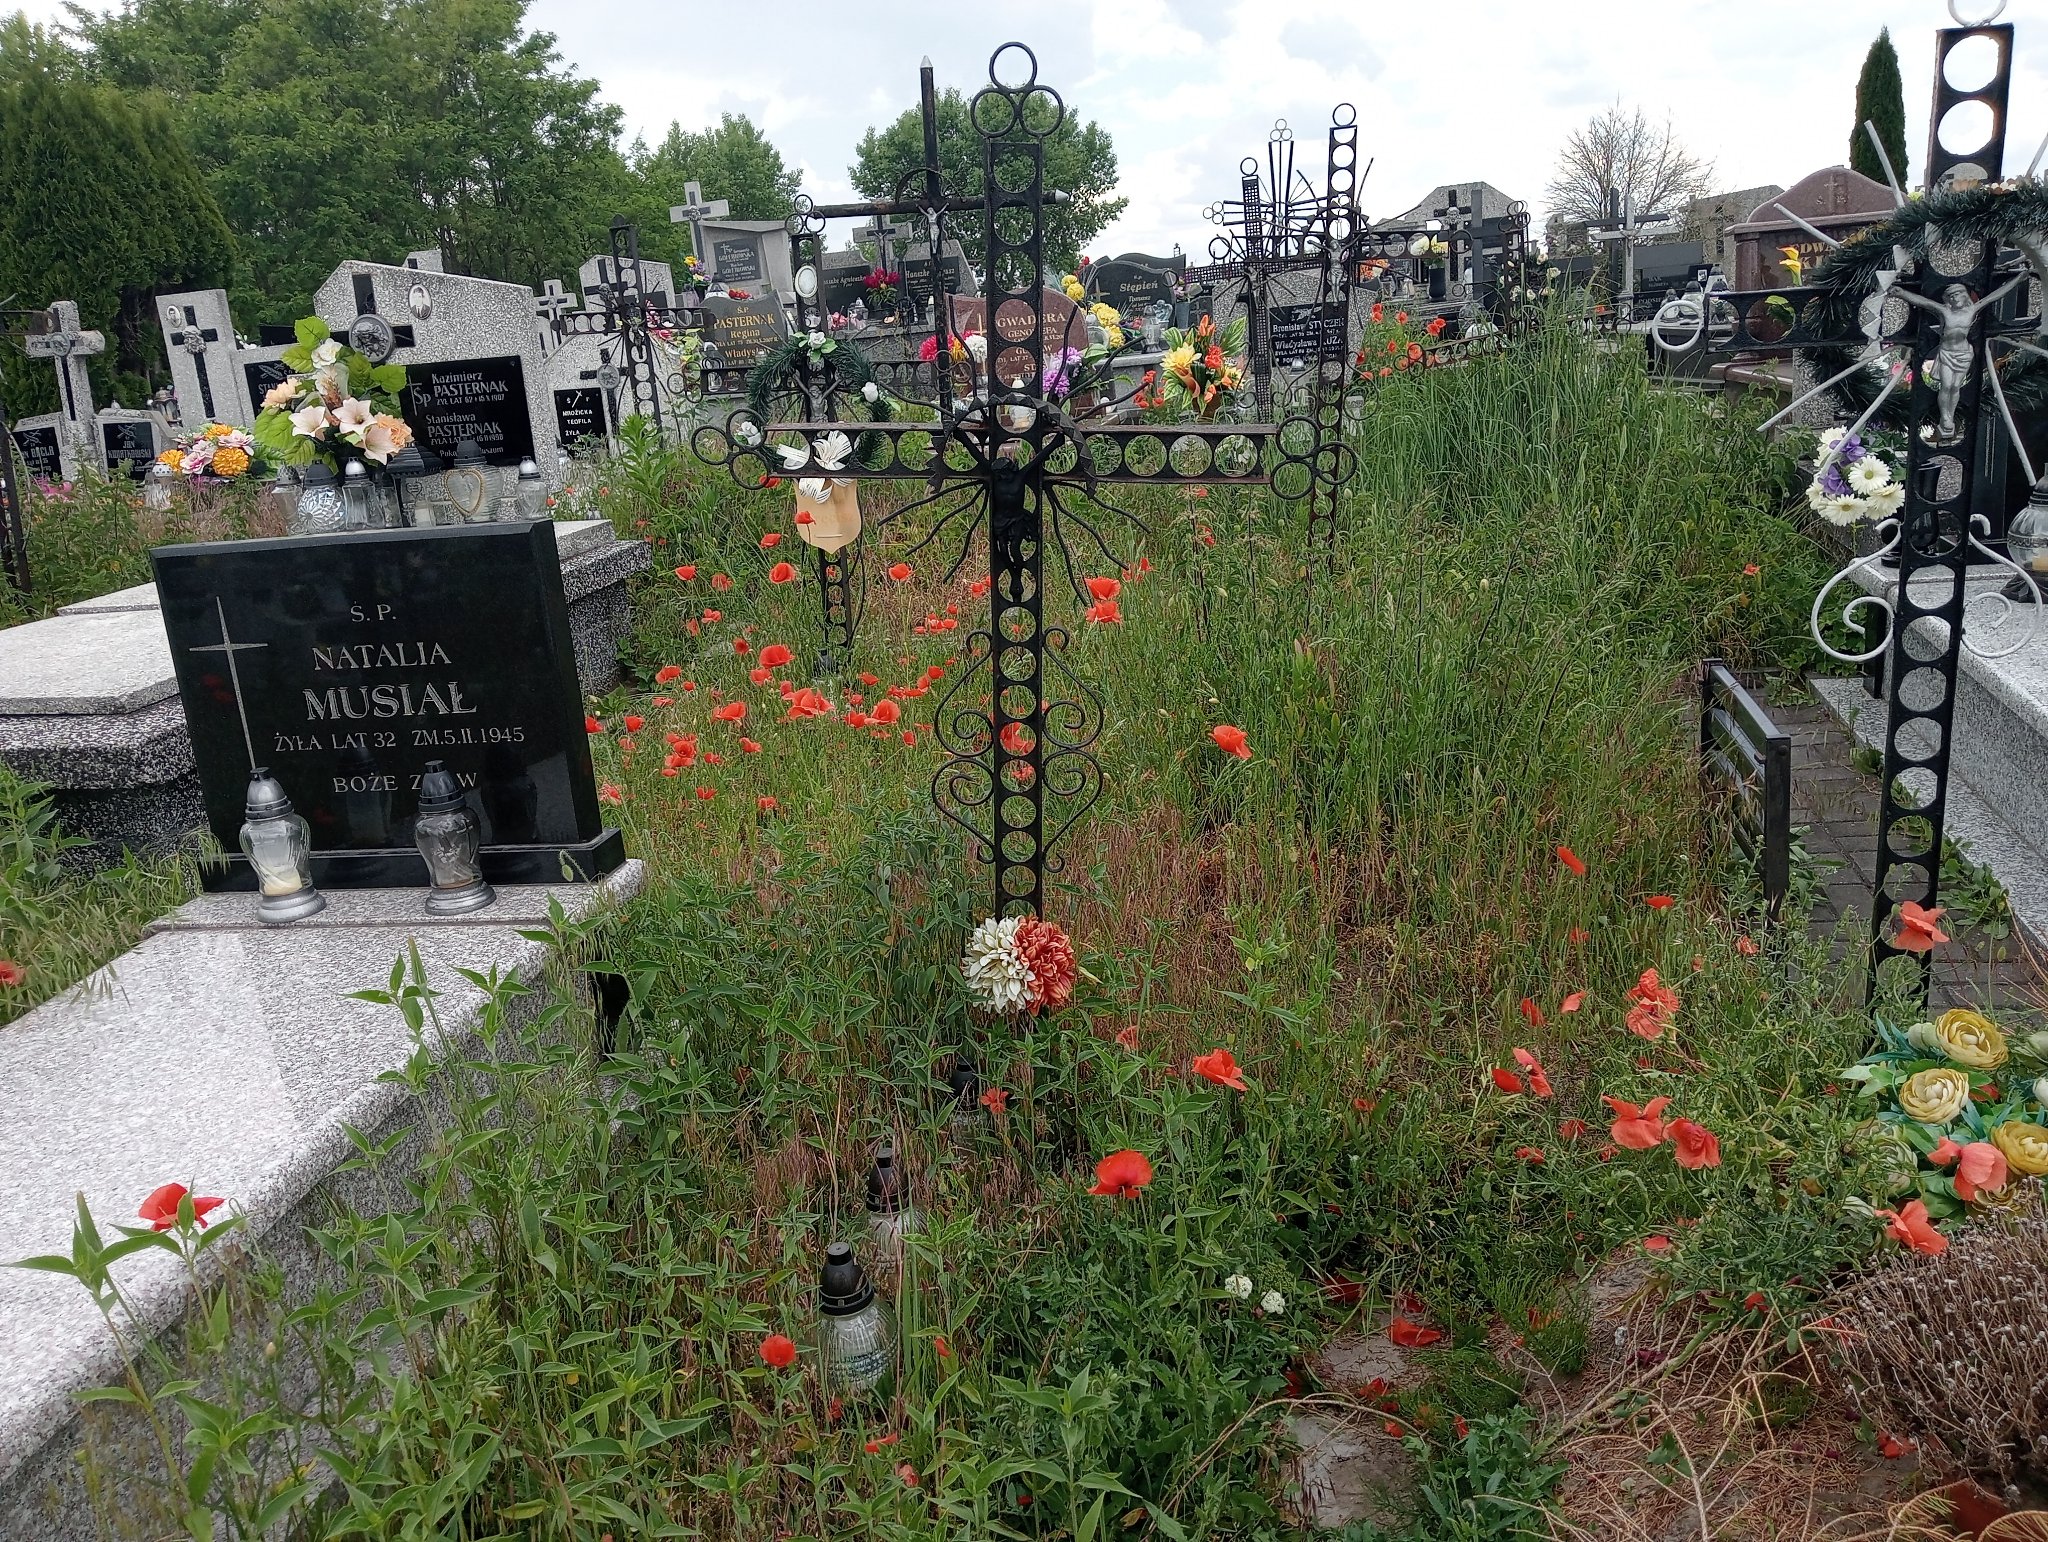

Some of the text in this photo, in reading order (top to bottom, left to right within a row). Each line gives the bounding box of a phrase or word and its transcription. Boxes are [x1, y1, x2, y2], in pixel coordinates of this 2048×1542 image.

[1120, 281, 1159, 293] Stępień
[714, 313, 776, 329] PASTERNAK
[730, 329, 761, 340] Regina
[431, 371, 483, 385] Kazimierz
[433, 380, 509, 398] PASTERNAK
[450, 396, 462, 405] LAT
[426, 412, 477, 425] Stanisława
[427, 421, 502, 438] PASTERNAK
[377, 603, 397, 622] P.
[312, 640, 452, 672] NATALIA
[303, 680, 478, 721] MUSIAŁ
[274, 731, 323, 753] ŻYŁA
[332, 731, 368, 751] LAT
[374, 731, 396, 748] 32
[333, 771, 398, 794] BOŻE
